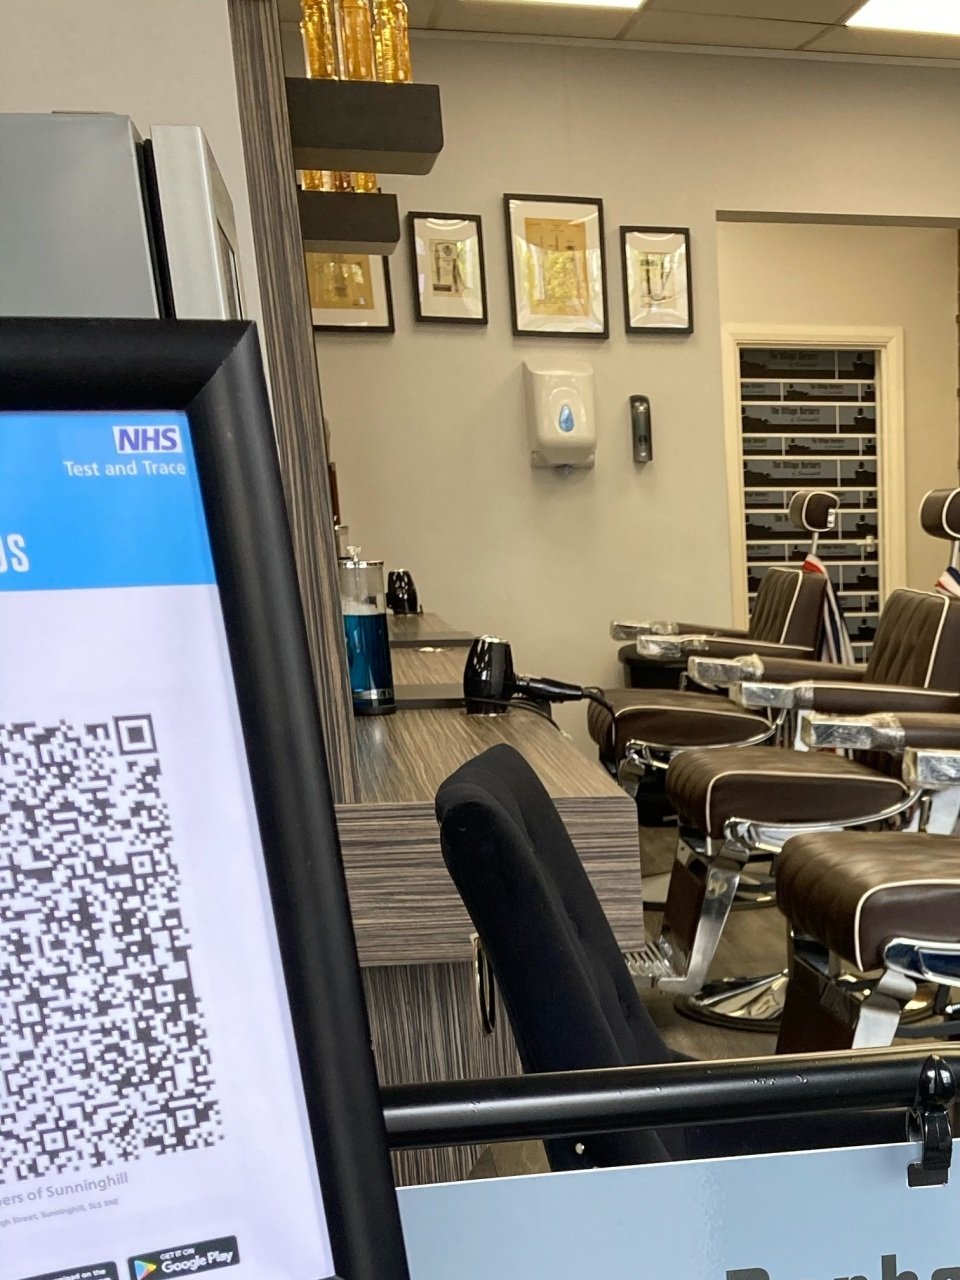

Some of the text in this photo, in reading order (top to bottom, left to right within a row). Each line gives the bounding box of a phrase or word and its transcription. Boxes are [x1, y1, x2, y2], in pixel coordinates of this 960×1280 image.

[118, 428, 178, 452] NHS
[63, 460, 187, 477] Test and Trace
[0, 1171, 129, 1207] ers of Sunninghill
[160, 1252, 175, 1261] GET
[182, 1248, 196, 1256] ON
[161, 1250, 234, 1275] Google Play
[81, 1271, 93, 1279] on
[93, 1268, 107, 1277] the
